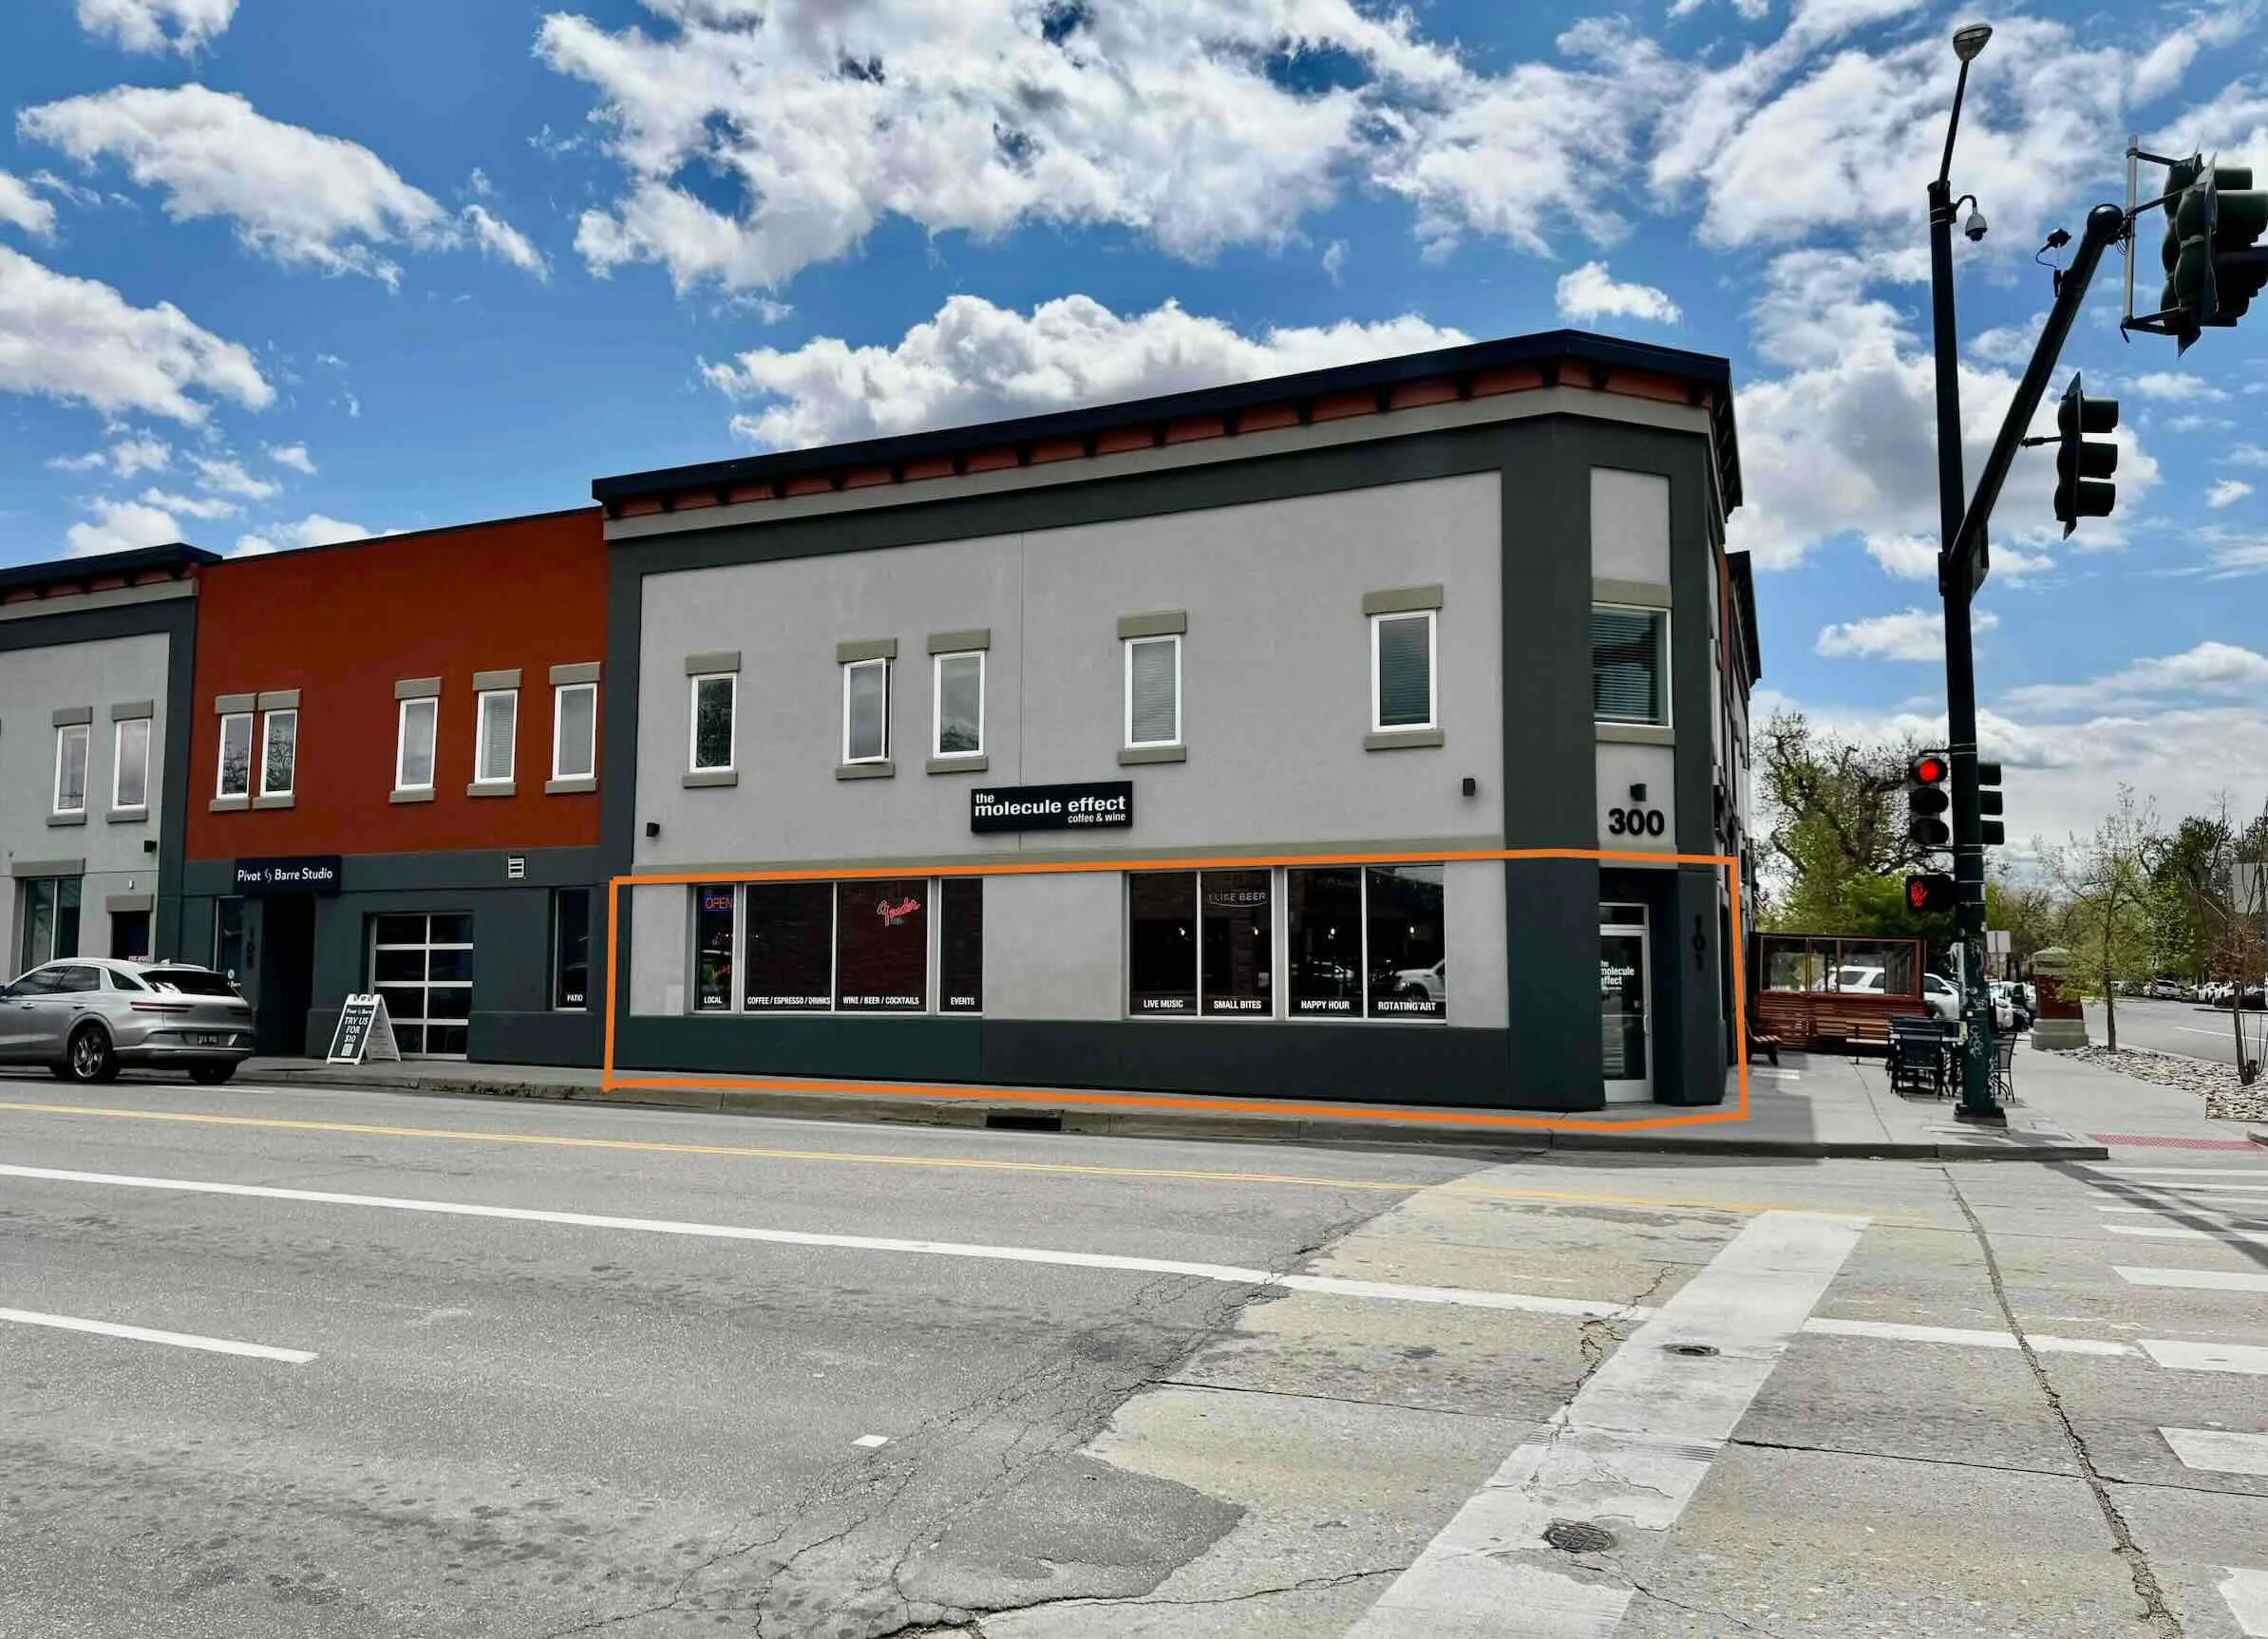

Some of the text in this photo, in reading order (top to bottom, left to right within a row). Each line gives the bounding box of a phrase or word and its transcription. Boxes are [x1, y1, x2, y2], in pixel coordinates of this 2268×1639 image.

[975, 793, 994, 804] the
[974, 796, 1126, 817] molecule effect
[1068, 811, 1126, 824] coffee & wine
[1608, 807, 1665, 837] 300
[236, 867, 333, 882] Pivot Barre Studio
[1238, 892, 1266, 902] BEER
[705, 896, 732, 910] OPEN
[704, 995, 722, 1005] LOCAL
[747, 996, 770, 1005] COFFEE
[773, 996, 804, 1005] ESPRESSO
[808, 996, 831, 1005] DRINKS
[842, 996, 860, 1005] WINE
[863, 996, 880, 1005] BEER
[885, 996, 920, 1006] COCKTAILS
[950, 996, 974, 1006] EVENTS
[1143, 999, 1183, 1008] LIVE MUSIC
[1213, 1000, 1262, 1009] SMALL BITES
[1300, 1000, 1351, 1010] HAPPY HOUR
[1377, 1001, 1437, 1011] ROTATING ART
[344, 1016, 369, 1026] TRY US
[344, 1034, 357, 1043] $10
